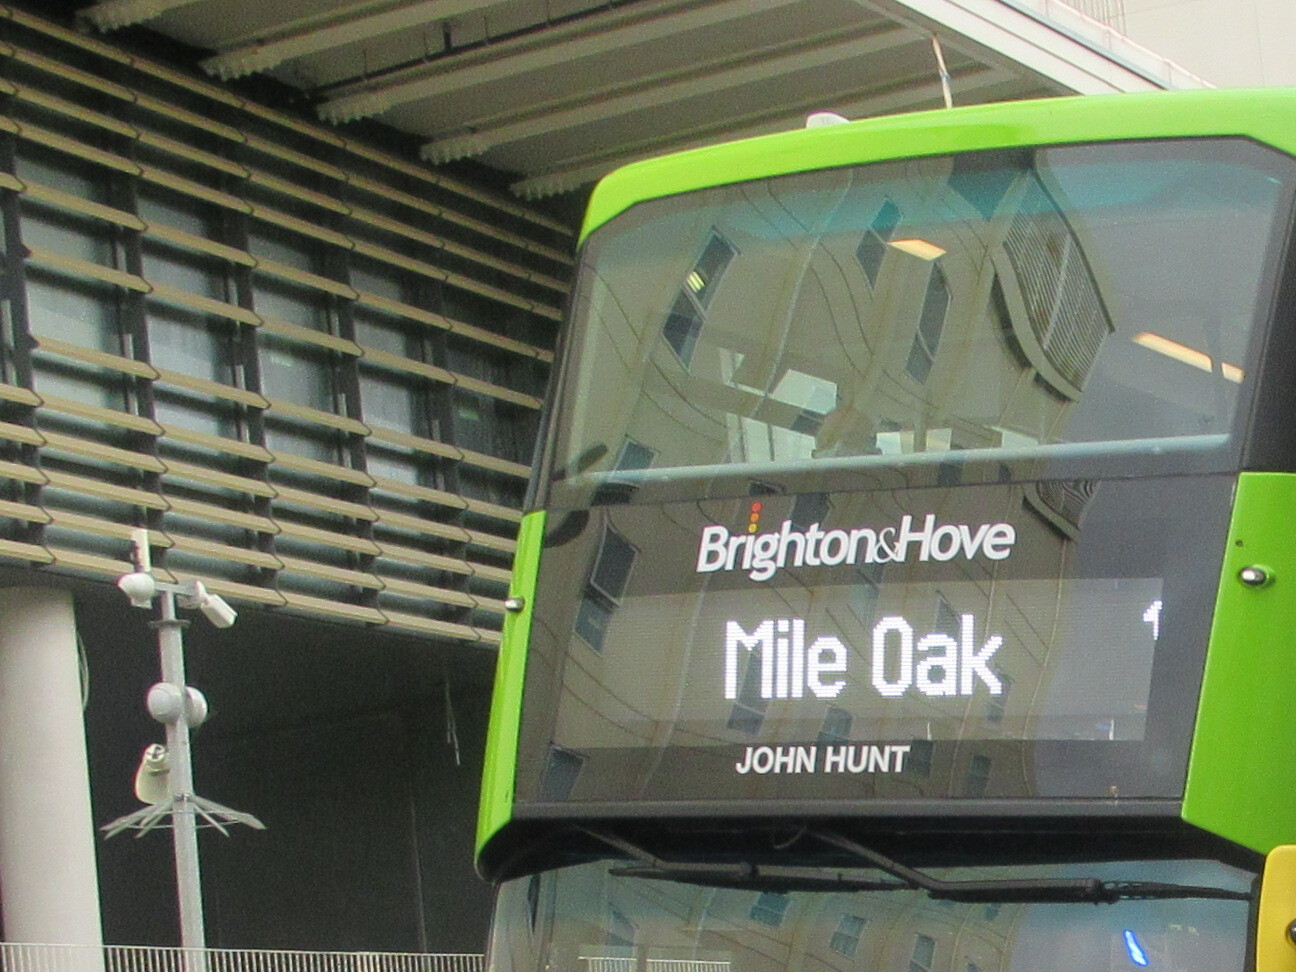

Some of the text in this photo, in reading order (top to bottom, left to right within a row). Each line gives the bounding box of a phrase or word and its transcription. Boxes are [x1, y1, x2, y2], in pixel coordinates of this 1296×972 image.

[725, 614, 1002, 699] Mile Oak
[735, 745, 911, 774] JOHN HUNT
